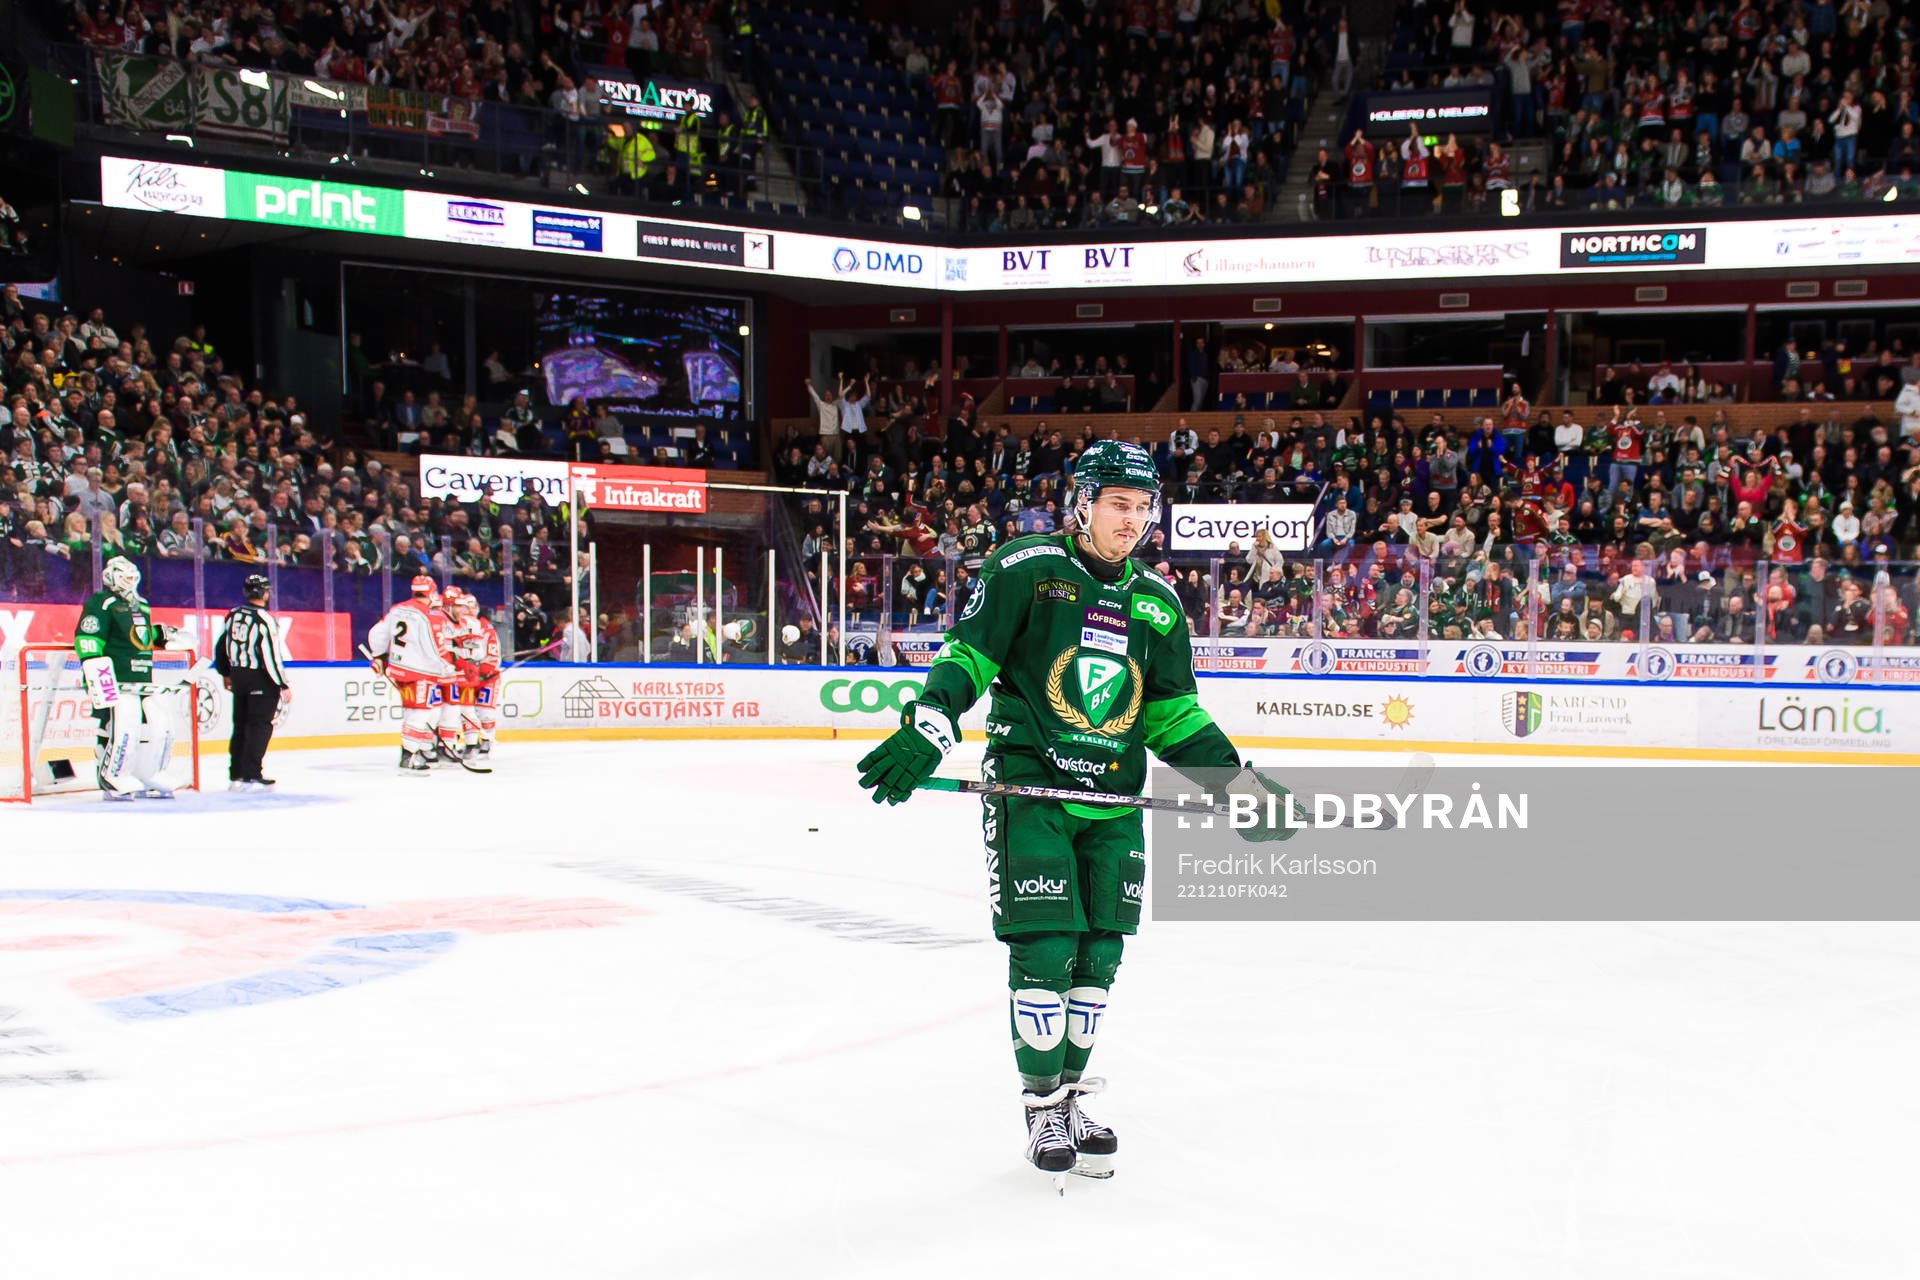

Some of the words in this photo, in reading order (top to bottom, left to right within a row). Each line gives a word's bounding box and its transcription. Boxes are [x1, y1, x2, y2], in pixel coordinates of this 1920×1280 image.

[255, 182, 377, 224] print
[447, 204, 506, 224] ELEKTRA
[642, 234, 669, 247] FIRST
[671, 237, 701, 250] HOTEL
[703, 241, 728, 252] RIVER
[1570, 233, 1697, 255] NORTHCOM
[866, 250, 924, 275] DMD
[1002, 249, 1052, 272] BVT
[1084, 246, 1134, 270] BVT
[425, 466, 565, 496] Caverion
[604, 485, 702, 509] Infrakraft
[1175, 514, 1310, 539] Caverion
[1098, 599, 1122, 610] CCM
[1087, 612, 1127, 628] LÖFBERGS
[393, 620, 408, 648] 2
[79, 638, 98, 653] 90
[1341, 649, 1397, 659] FRANCKS
[1341, 660, 1421, 673] KYLINDUSTRI
[1681, 654, 1741, 665] FRANCKS
[96, 665, 118, 702] MEX
[1087, 663, 1106, 689] F
[344, 681, 387, 702] pre
[632, 681, 725, 696] KARLSTADS
[820, 679, 926, 713] coo
[598, 697, 725, 720] BYGGTJÄNST
[732, 701, 760, 719] AB
[1256, 701, 1374, 718] KARLSTAD.SE
[1550, 695, 1627, 709] KARLSTAD
[1758, 696, 1892, 735] Länia.
[1072, 734, 1119, 749] KARLSTAD
[1018, 785, 1118, 803] JETSPEED
[1013, 874, 1064, 894] voky
